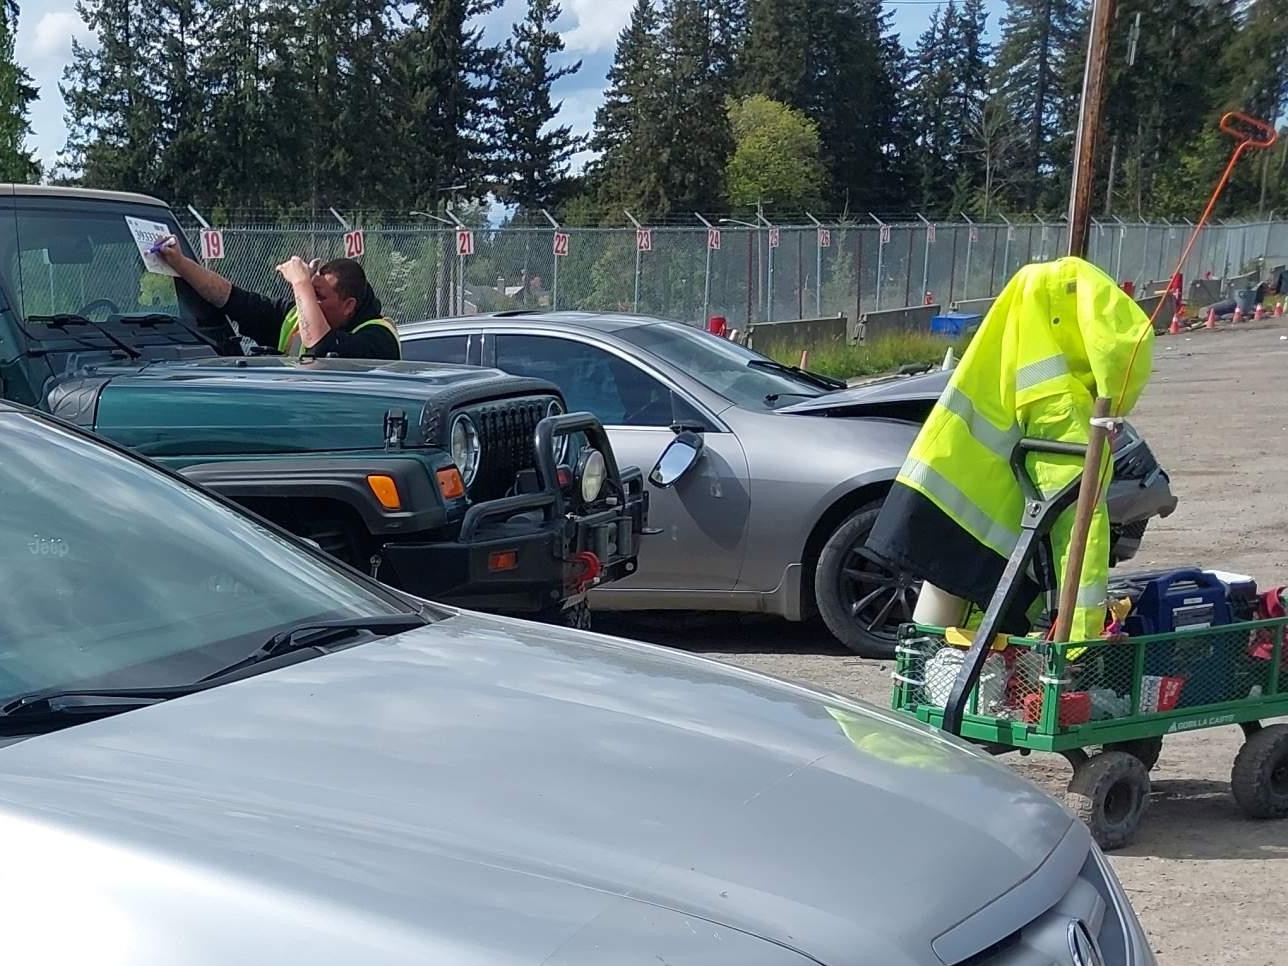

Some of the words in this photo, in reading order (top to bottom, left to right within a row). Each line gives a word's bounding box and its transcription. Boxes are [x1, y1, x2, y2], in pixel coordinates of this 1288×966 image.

[204, 231, 222, 258] 19
[345, 231, 363, 257] 20
[459, 232, 471, 254] 21
[554, 234, 567, 254] 22
[637, 231, 650, 250] 23
[709, 231, 720, 248] 24
[820, 230, 831, 246] 26
